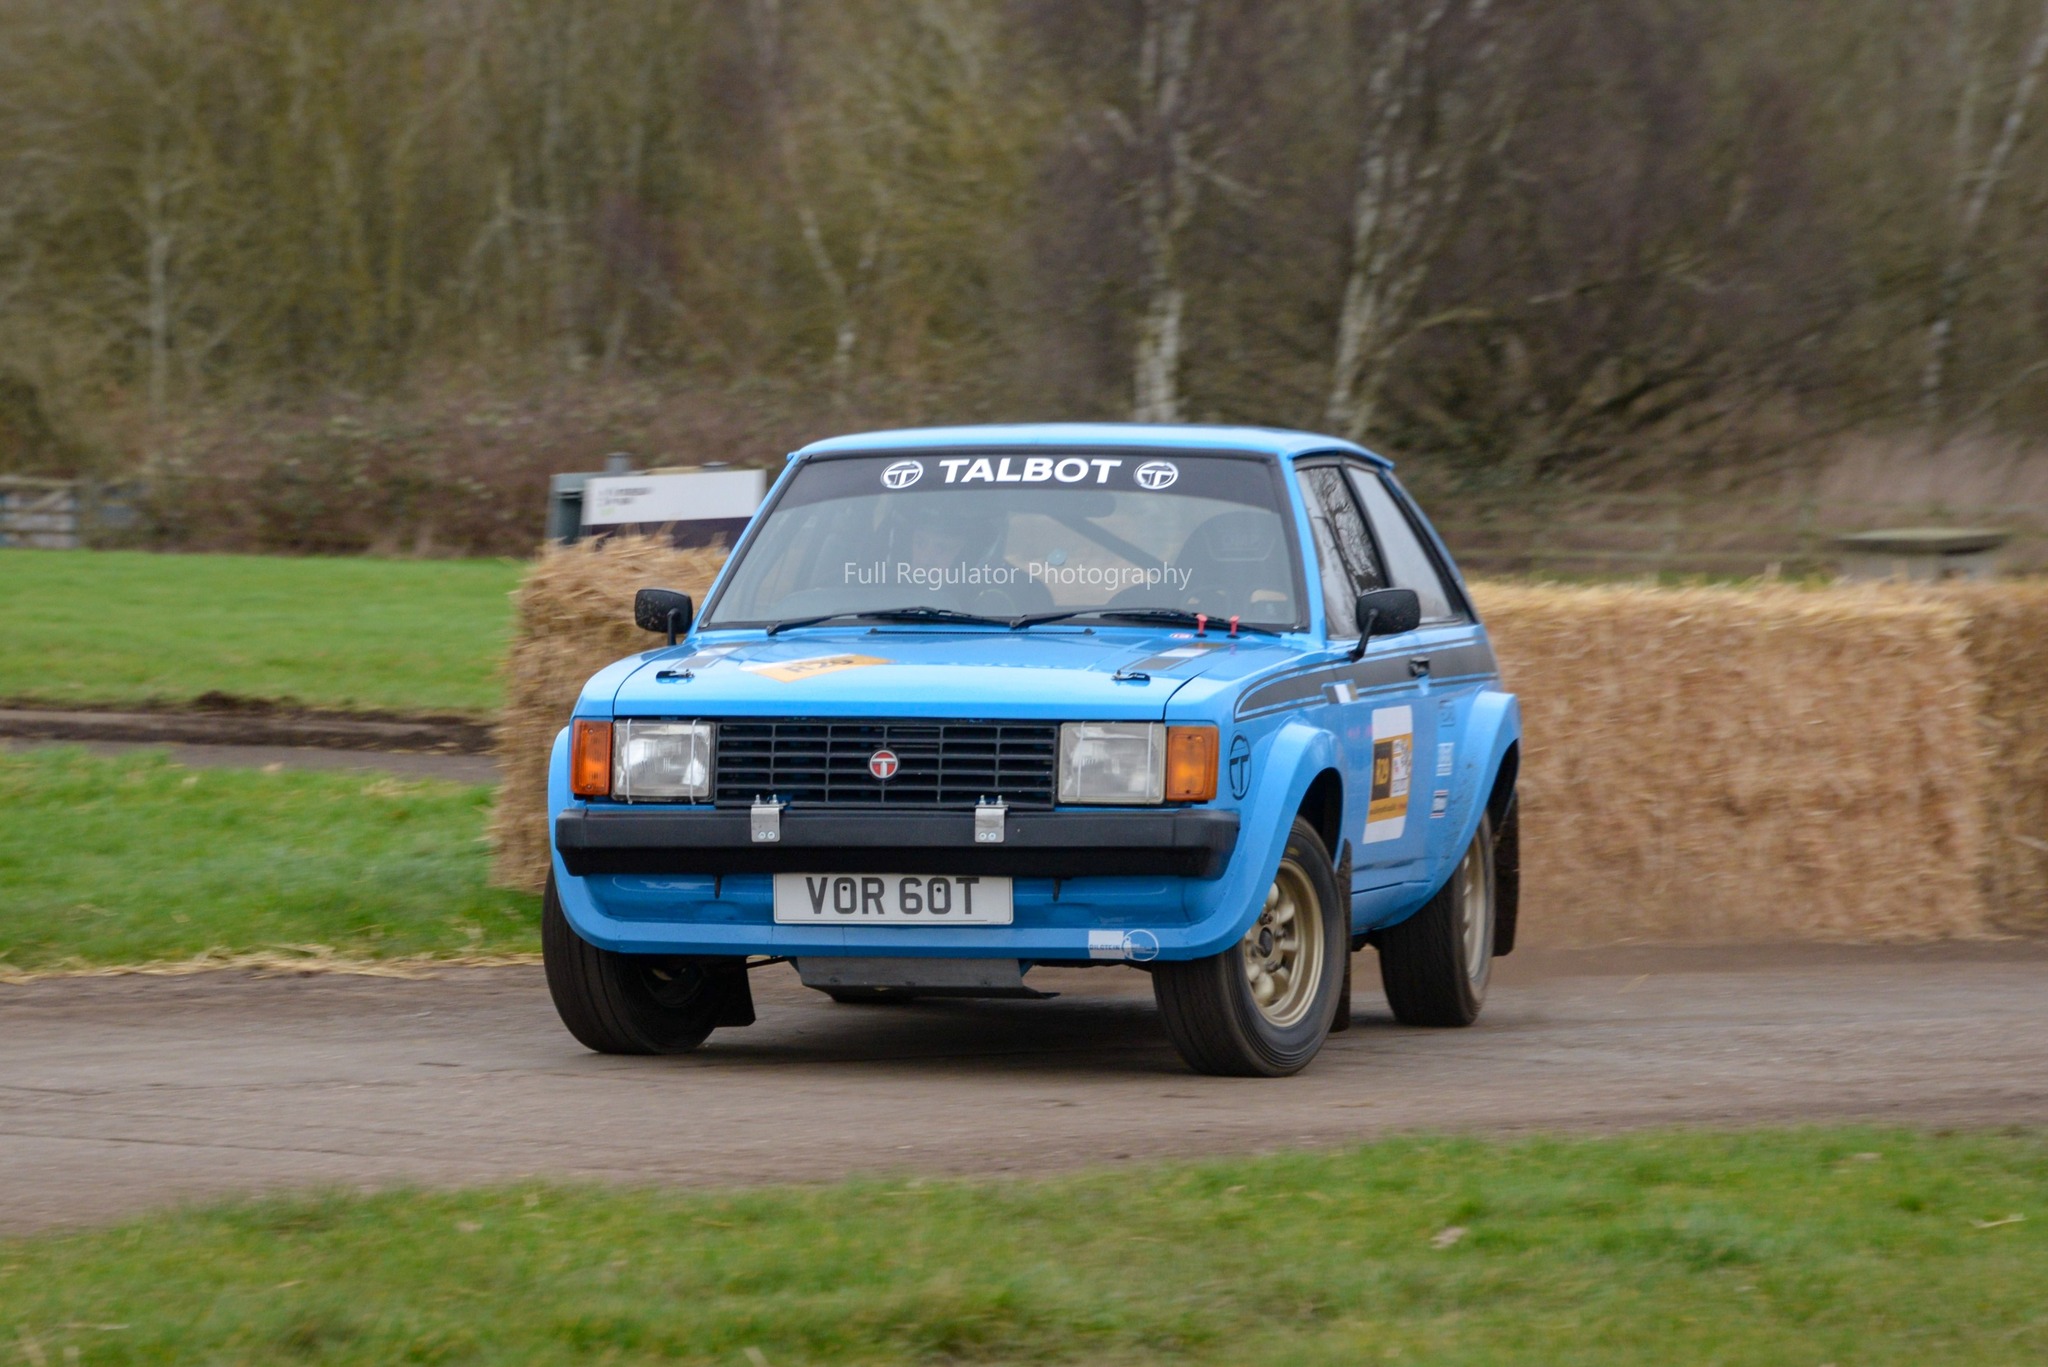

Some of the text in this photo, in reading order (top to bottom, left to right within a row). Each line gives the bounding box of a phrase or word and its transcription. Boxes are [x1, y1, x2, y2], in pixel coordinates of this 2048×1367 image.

[938, 457, 1123, 484] TALBOT
[806, 877, 980, 914] VOR 60T
